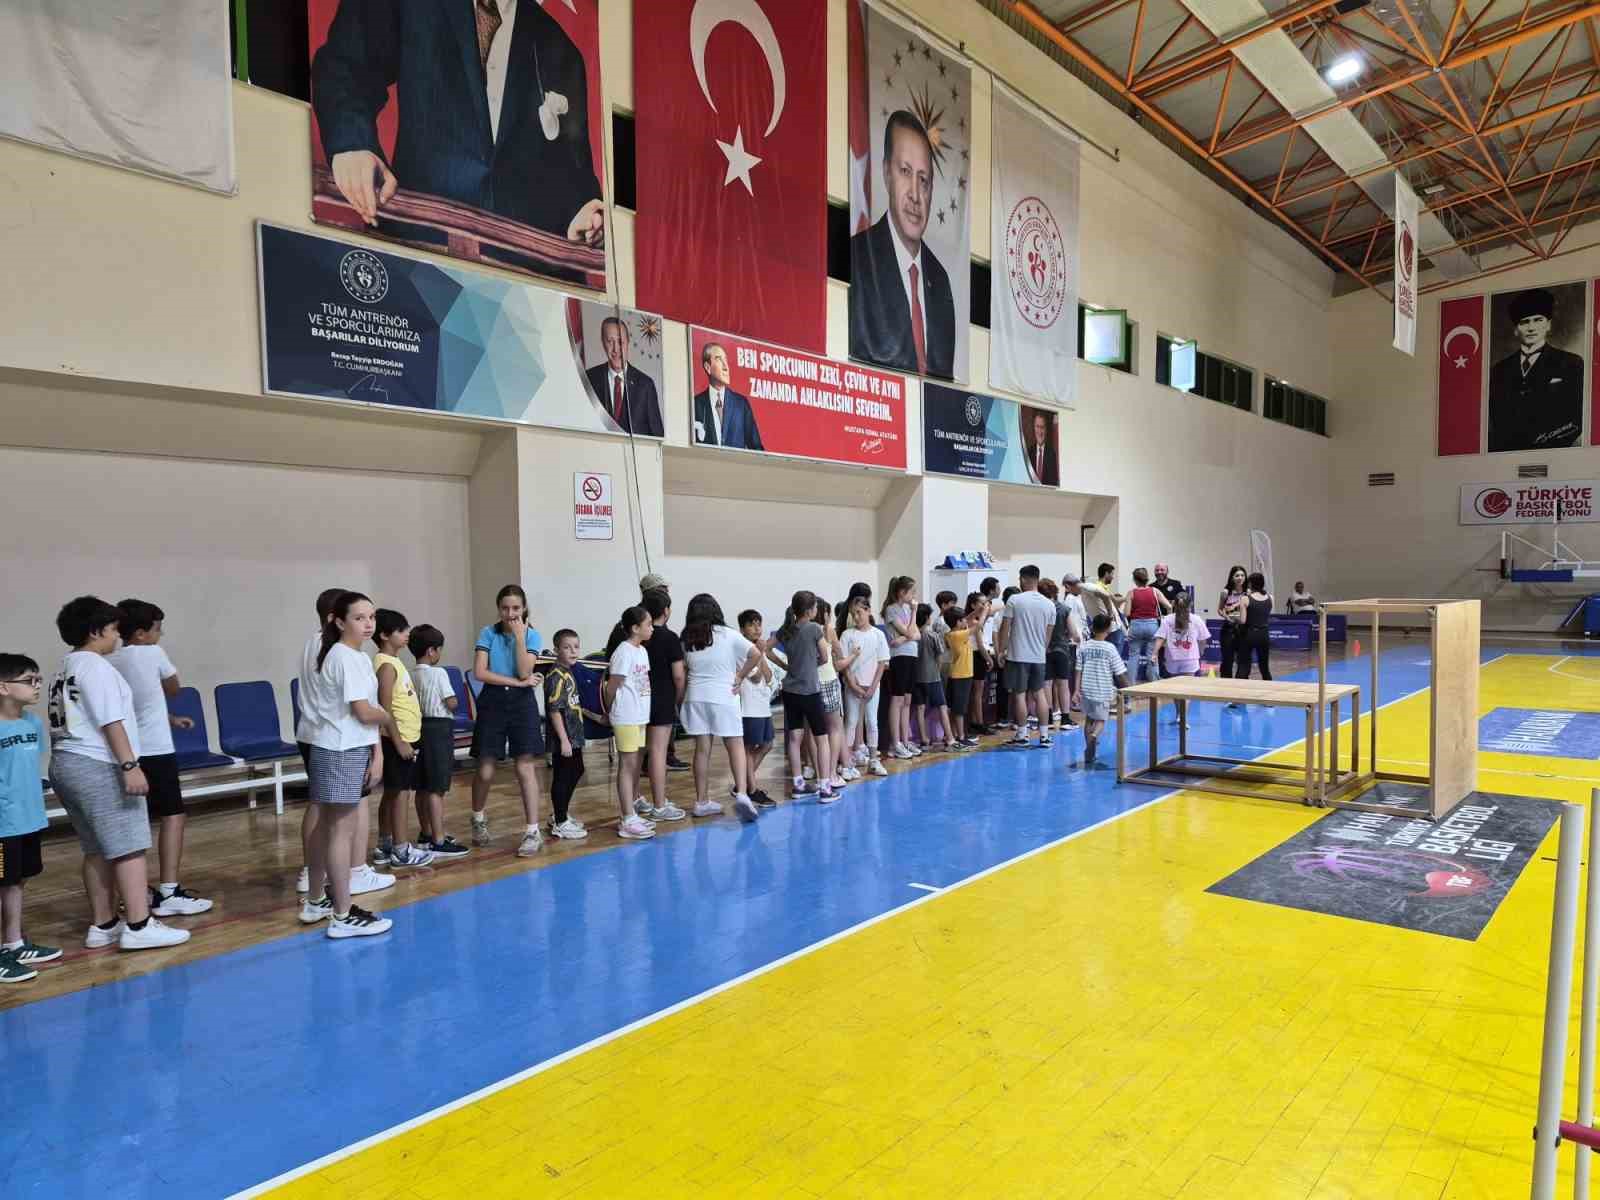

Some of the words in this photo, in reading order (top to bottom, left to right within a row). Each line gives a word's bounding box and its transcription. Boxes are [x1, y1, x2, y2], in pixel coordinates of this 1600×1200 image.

[308, 312, 323, 325] VE
[326, 316, 421, 342] SPORCULARIMIZA
[320, 302, 348, 317] TÜM
[350, 309, 408, 328] ANTRENÖR
[311, 327, 367, 344] BAŞARILAR
[368, 335, 420, 352] DİLİYORUM
[737, 346, 757, 370] BEN
[760, 351, 818, 381] SPORCUNUN
[820, 363, 842, 390] ZEKİ,
[844, 368, 868, 394] ÇEVİK
[869, 374, 880, 395] VE
[881, 379, 900, 401] AYNI
[749, 377, 798, 404] ZAMANDA
[1516, 485, 1592, 500] TÜRKİYE
[1417, 805, 1499, 855] BASKETBOL
[1463, 838, 1517, 861] LİGİ
